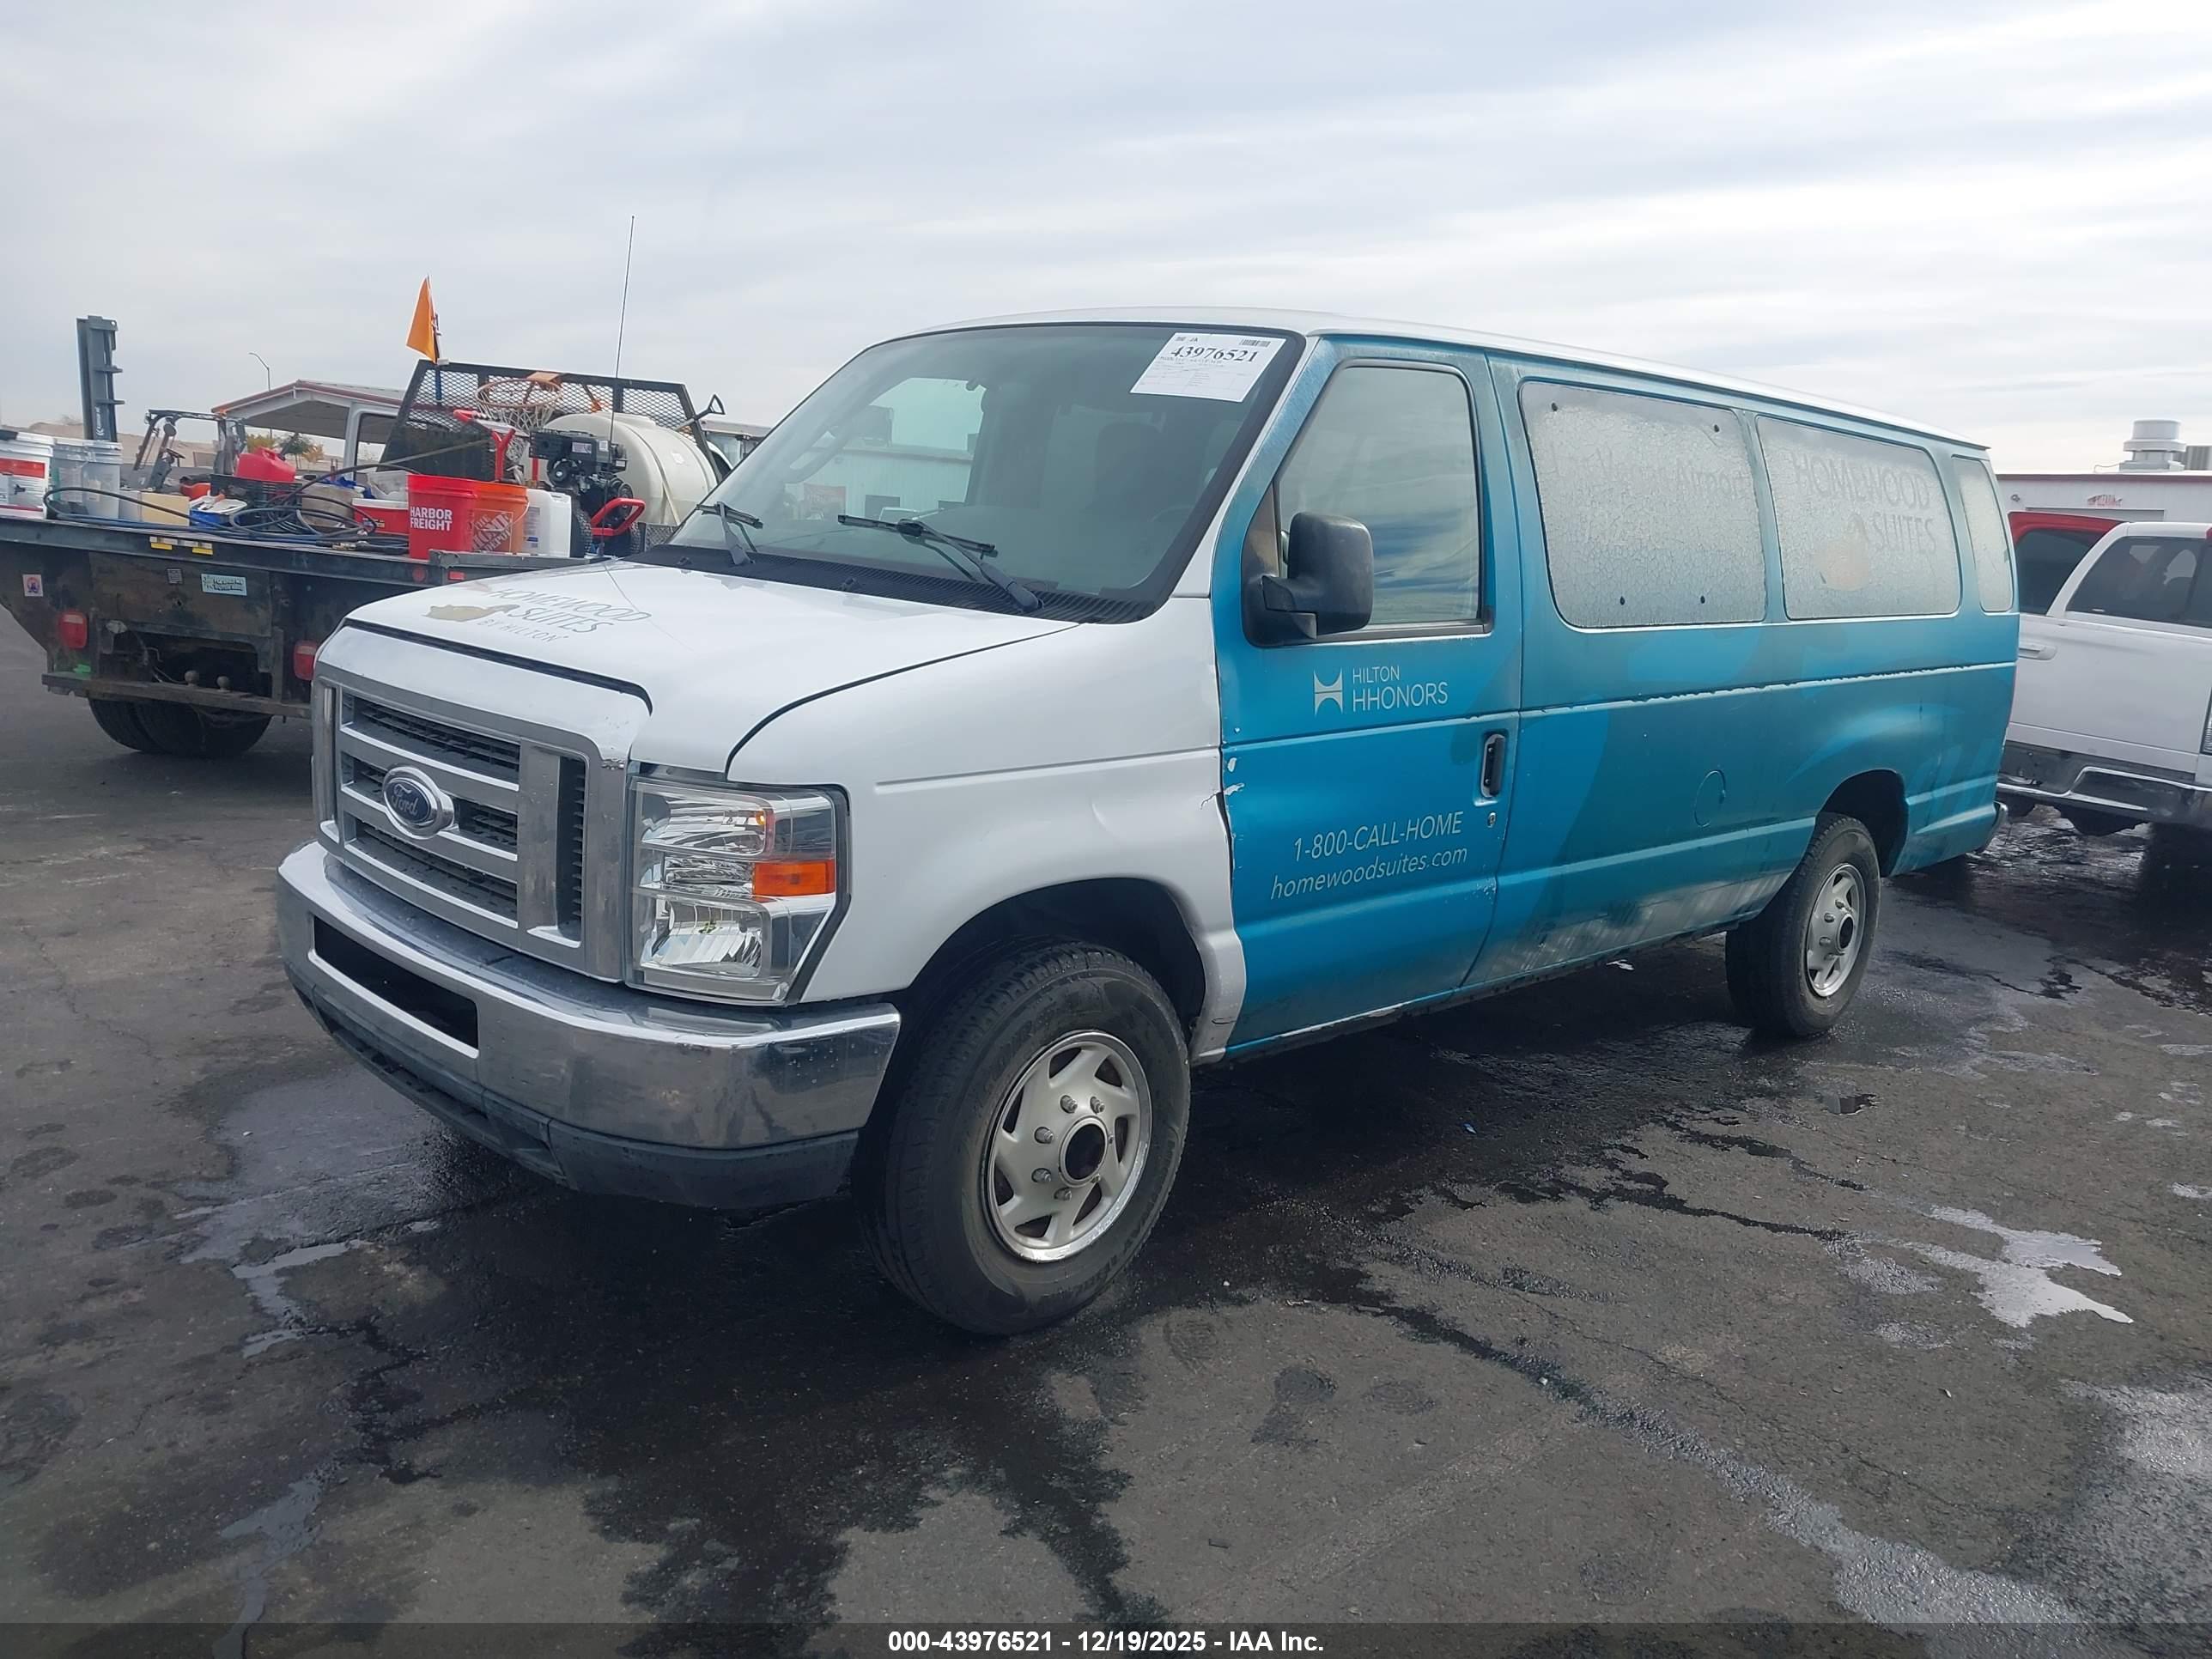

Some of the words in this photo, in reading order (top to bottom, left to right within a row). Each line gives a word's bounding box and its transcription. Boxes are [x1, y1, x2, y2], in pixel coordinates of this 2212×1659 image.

[1170, 346, 1259, 362] 43976521
[1791, 452, 1930, 509] HOMEWOOD
[410, 506, 453, 520] HARBOR
[410, 517, 453, 532] FREIGHT
[1872, 510, 1937, 555] SUITES
[489, 588, 653, 622] HOMEWOOD
[507, 607, 614, 633] SUITES
[1352, 665, 1401, 684] HILTON
[1352, 682, 1449, 712] HHONORS
[392, 783, 419, 816] Ford
[1293, 811, 1464, 862] 1-800-CALL-HOME
[1270, 847, 1468, 901] homewoodsuites.com
